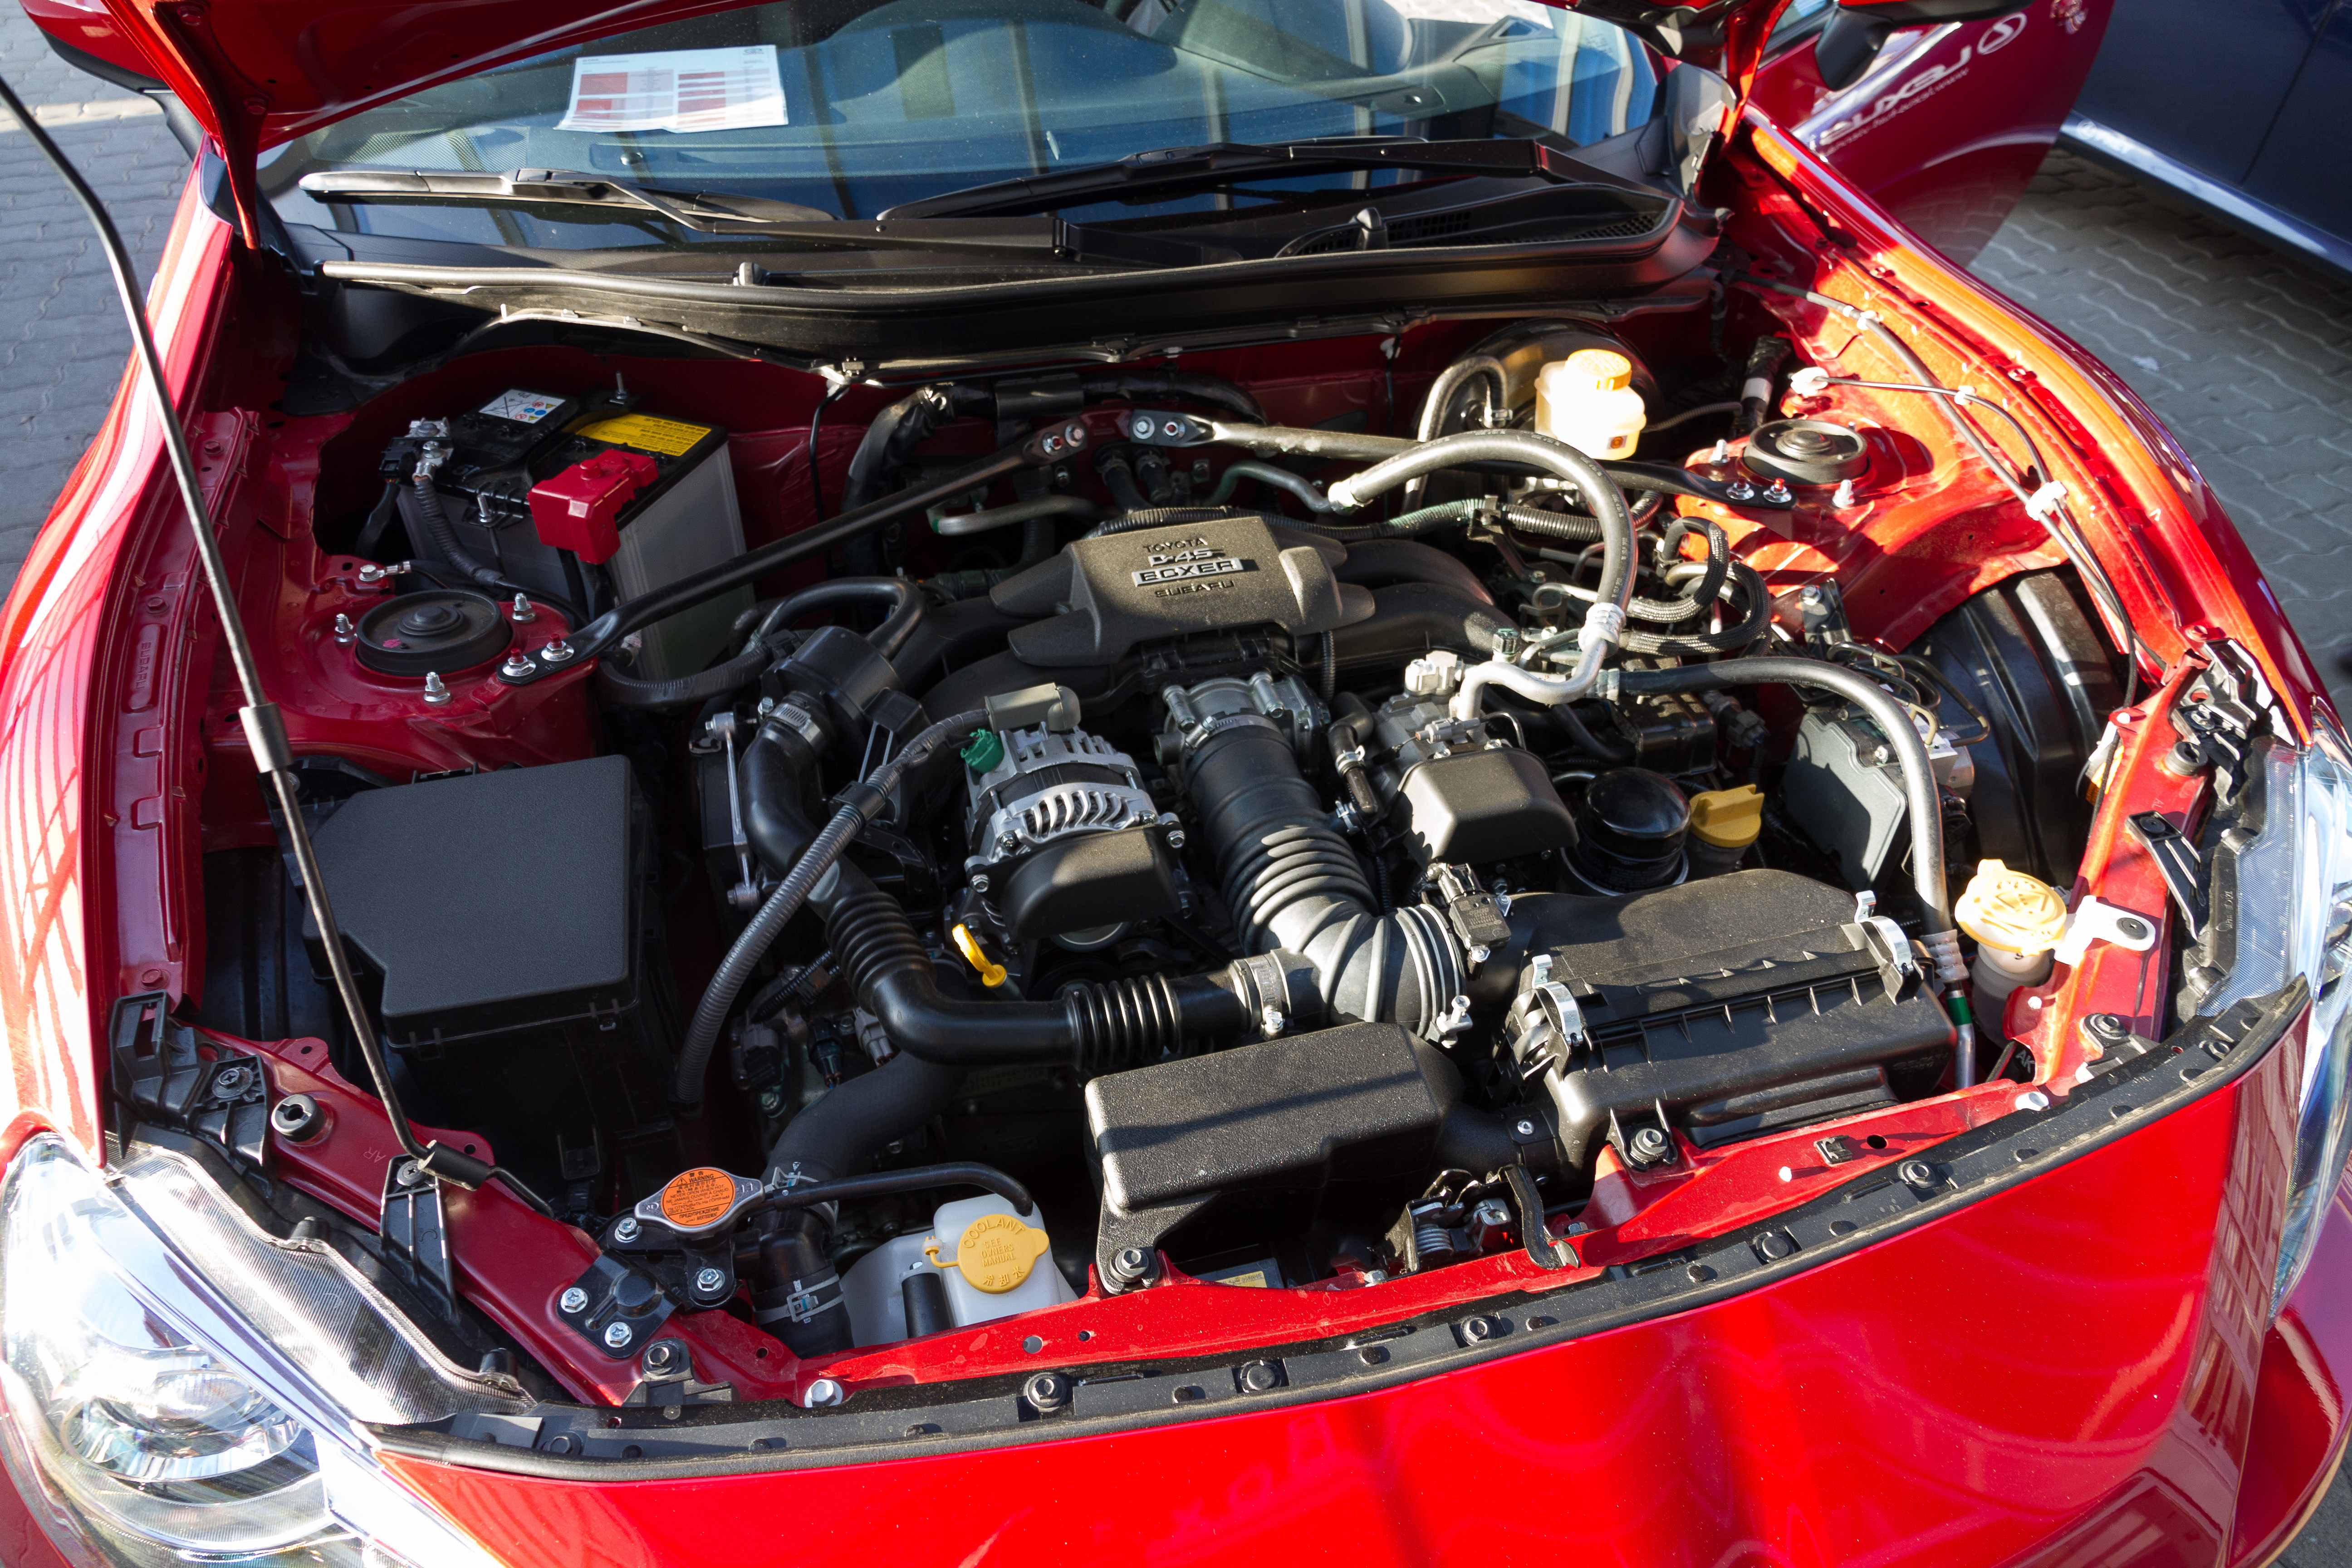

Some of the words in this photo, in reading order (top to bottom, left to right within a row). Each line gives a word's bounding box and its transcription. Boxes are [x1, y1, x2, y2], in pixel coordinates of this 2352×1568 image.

[1143, 538, 1208, 553] TOYOTA
[1148, 547, 1213, 567] D-4S
[1139, 560, 1237, 582] BOXER
[1154, 580, 1235, 598] SUBARU
[135, 642, 151, 689] SUBARU
[689, 1174, 714, 1183] WARNING
[679, 1206, 720, 1219] ПРЕДУПРЕЖДЕНИЕ
[963, 1217, 1025, 1249] COOLANT
[980, 1243, 1014, 1258] OWNERS
[984, 1238, 1000, 1248] SEE
[982, 1252, 1016, 1267] MANUAL
[983, 1266, 1024, 1287] 冷却水
